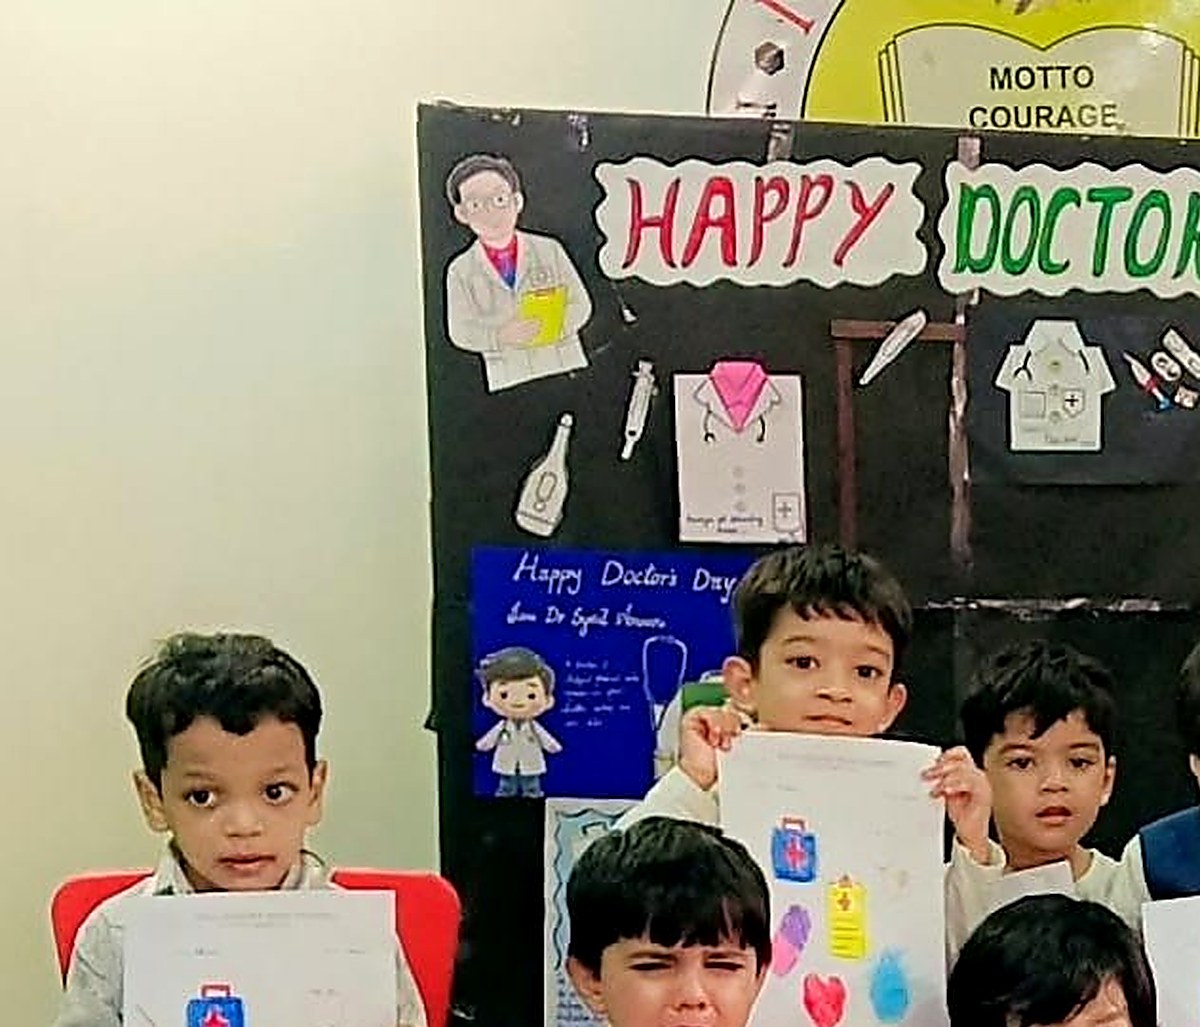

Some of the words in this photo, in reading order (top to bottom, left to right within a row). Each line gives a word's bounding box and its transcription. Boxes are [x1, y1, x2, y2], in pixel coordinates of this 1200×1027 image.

[990, 65, 1094, 90] MOTTO
[622, 174, 895, 268] HAPPY
[512, 551, 582, 596] Happy
[692, 567, 737, 604] Day
